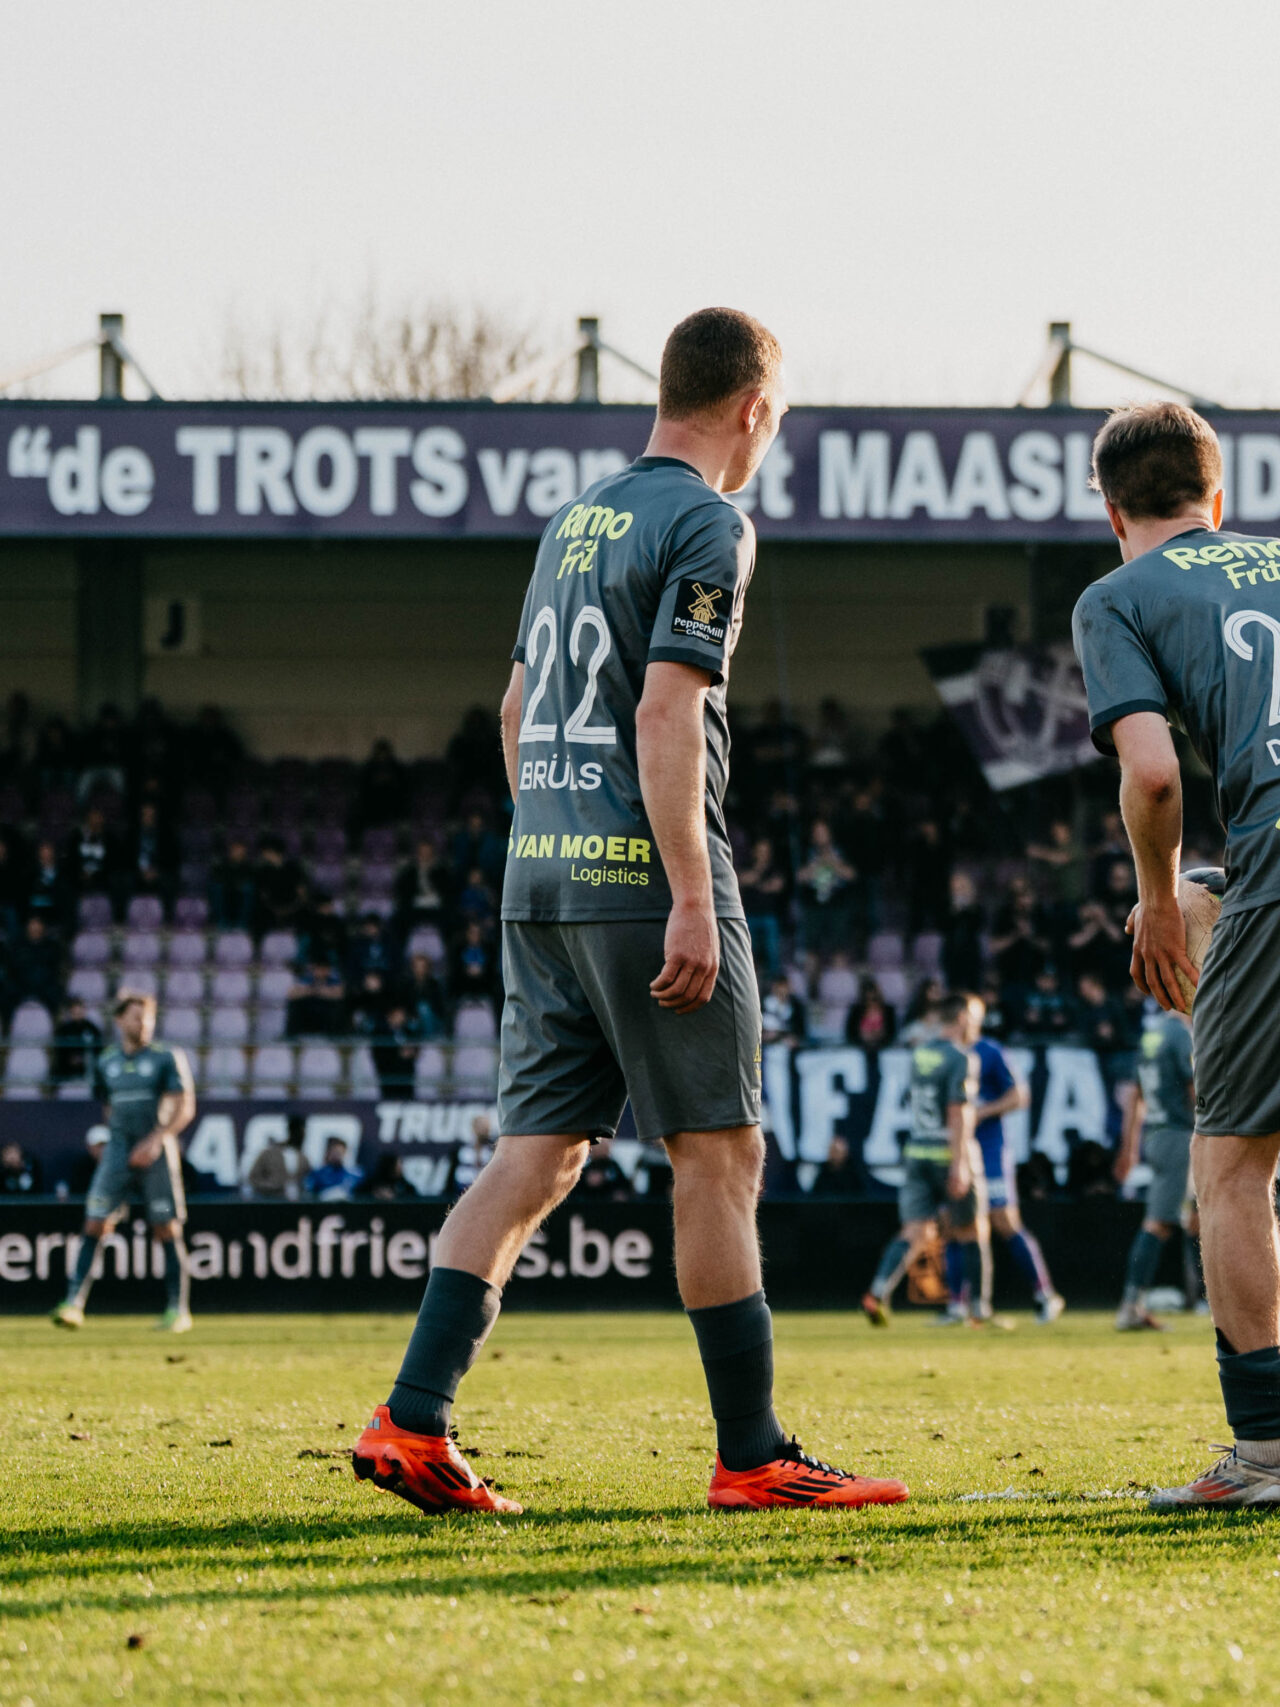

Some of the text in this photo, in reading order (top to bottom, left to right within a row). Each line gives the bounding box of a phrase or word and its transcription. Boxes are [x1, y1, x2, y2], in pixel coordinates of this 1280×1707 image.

[176, 427, 468, 518] TROTS
[556, 504, 634, 540] Remo
[556, 539, 598, 580] Frit
[674, 616, 724, 639] PepperMill
[685, 628, 710, 641] CASINO
[518, 605, 617, 744] 22
[519, 753, 604, 791] BRÜLS
[515, 834, 651, 864] VAN MOER
[571, 863, 649, 887] Logistics
